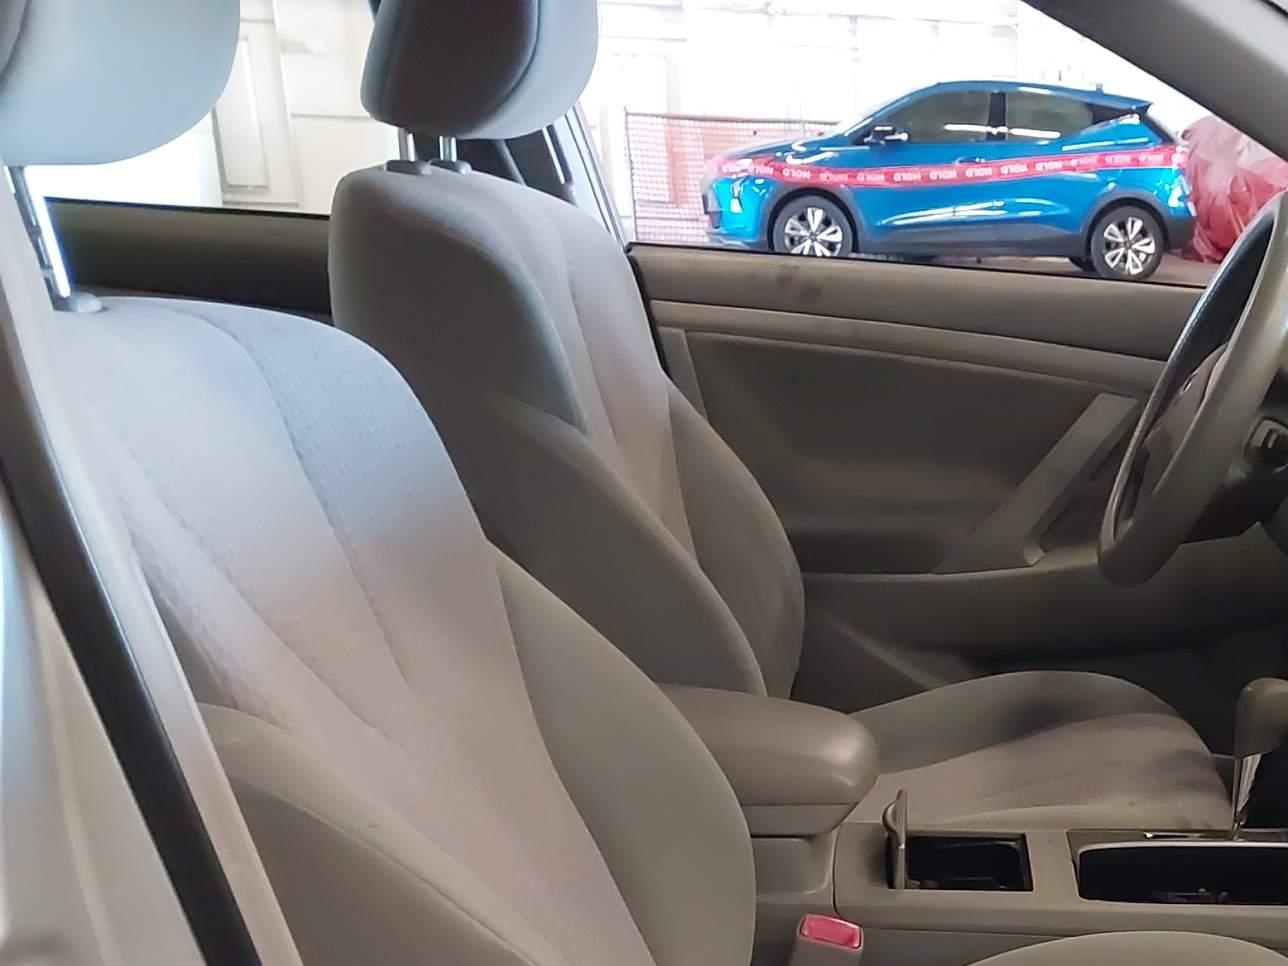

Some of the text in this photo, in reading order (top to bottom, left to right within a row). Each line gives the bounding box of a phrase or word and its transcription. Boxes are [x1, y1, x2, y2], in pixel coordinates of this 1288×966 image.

[783, 167, 811, 180] HOLD
[893, 171, 921, 182] HOLD
[929, 169, 957, 180] HOLD
[965, 167, 992, 177] HOLD
[1001, 164, 1028, 174] HOLD
[1035, 161, 1062, 171] HOLD
